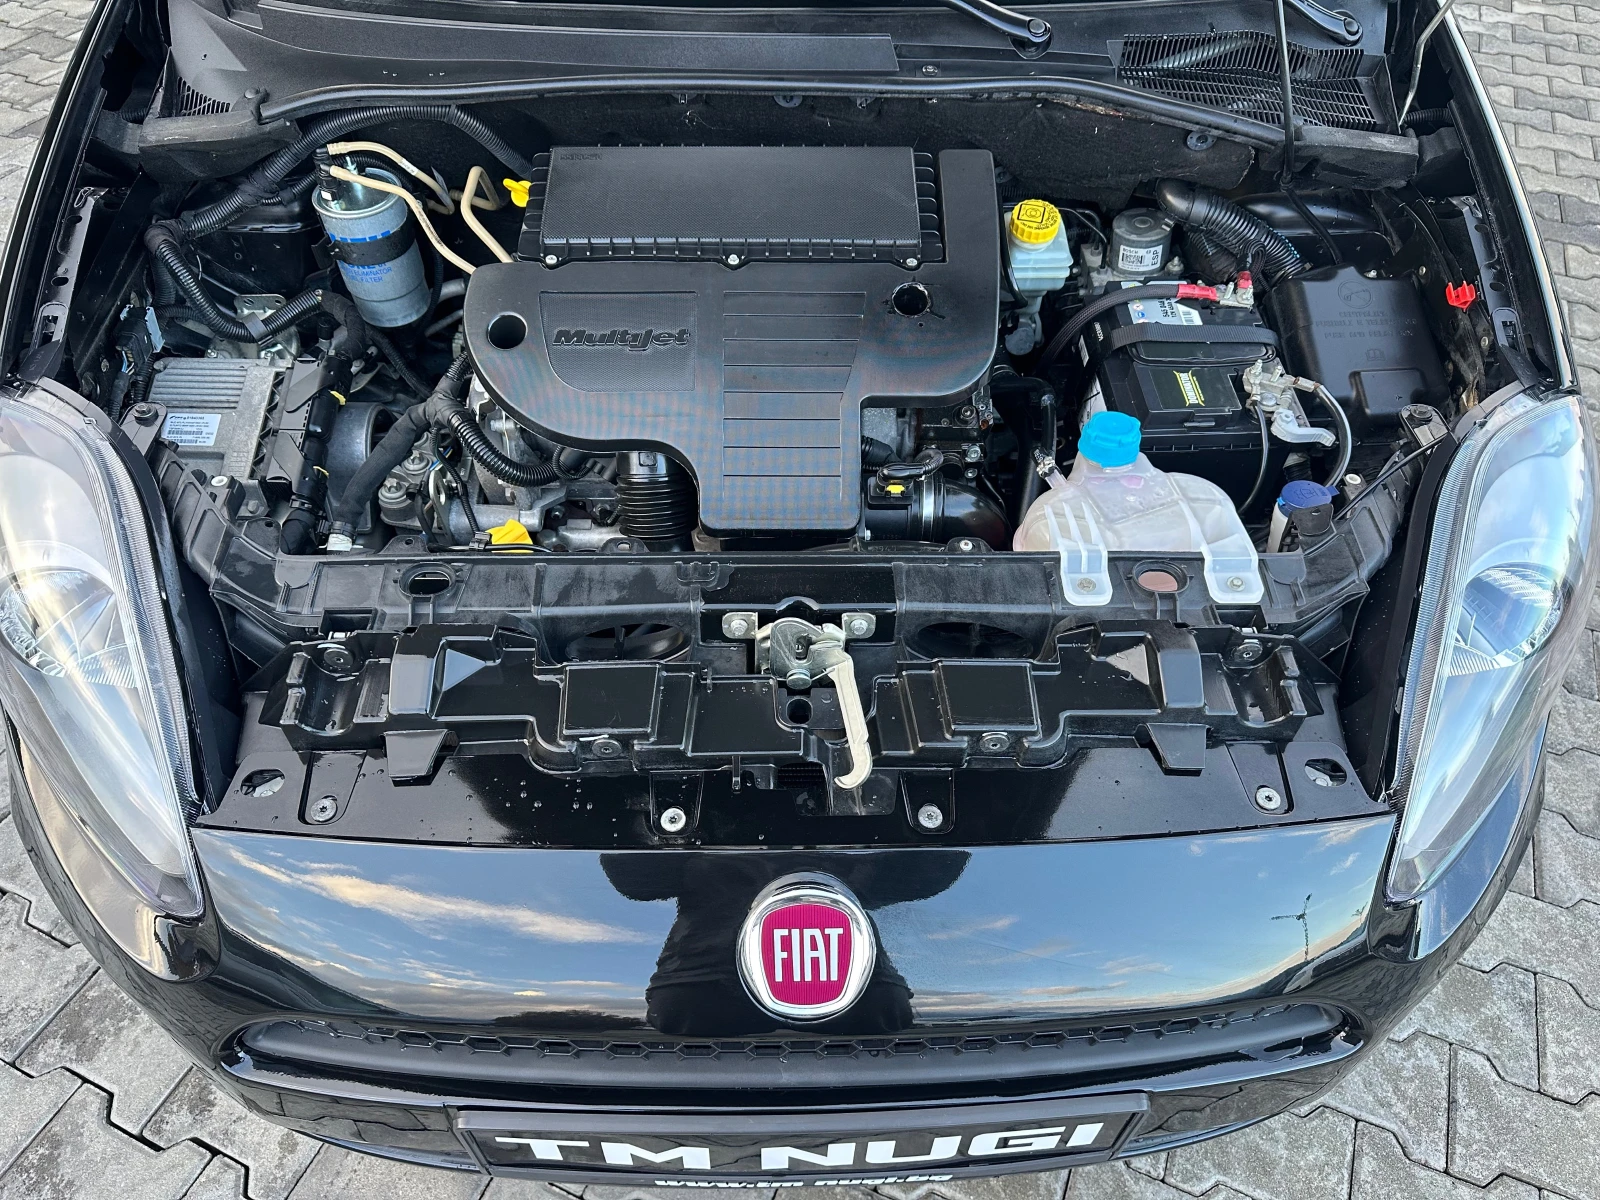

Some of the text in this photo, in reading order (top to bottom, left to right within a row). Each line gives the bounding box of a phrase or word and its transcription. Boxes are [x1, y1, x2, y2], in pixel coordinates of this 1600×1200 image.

[1151, 249, 1159, 266] ESP
[773, 928, 844, 982] FIAT
[495, 1122, 1105, 1170] TM NUGI
